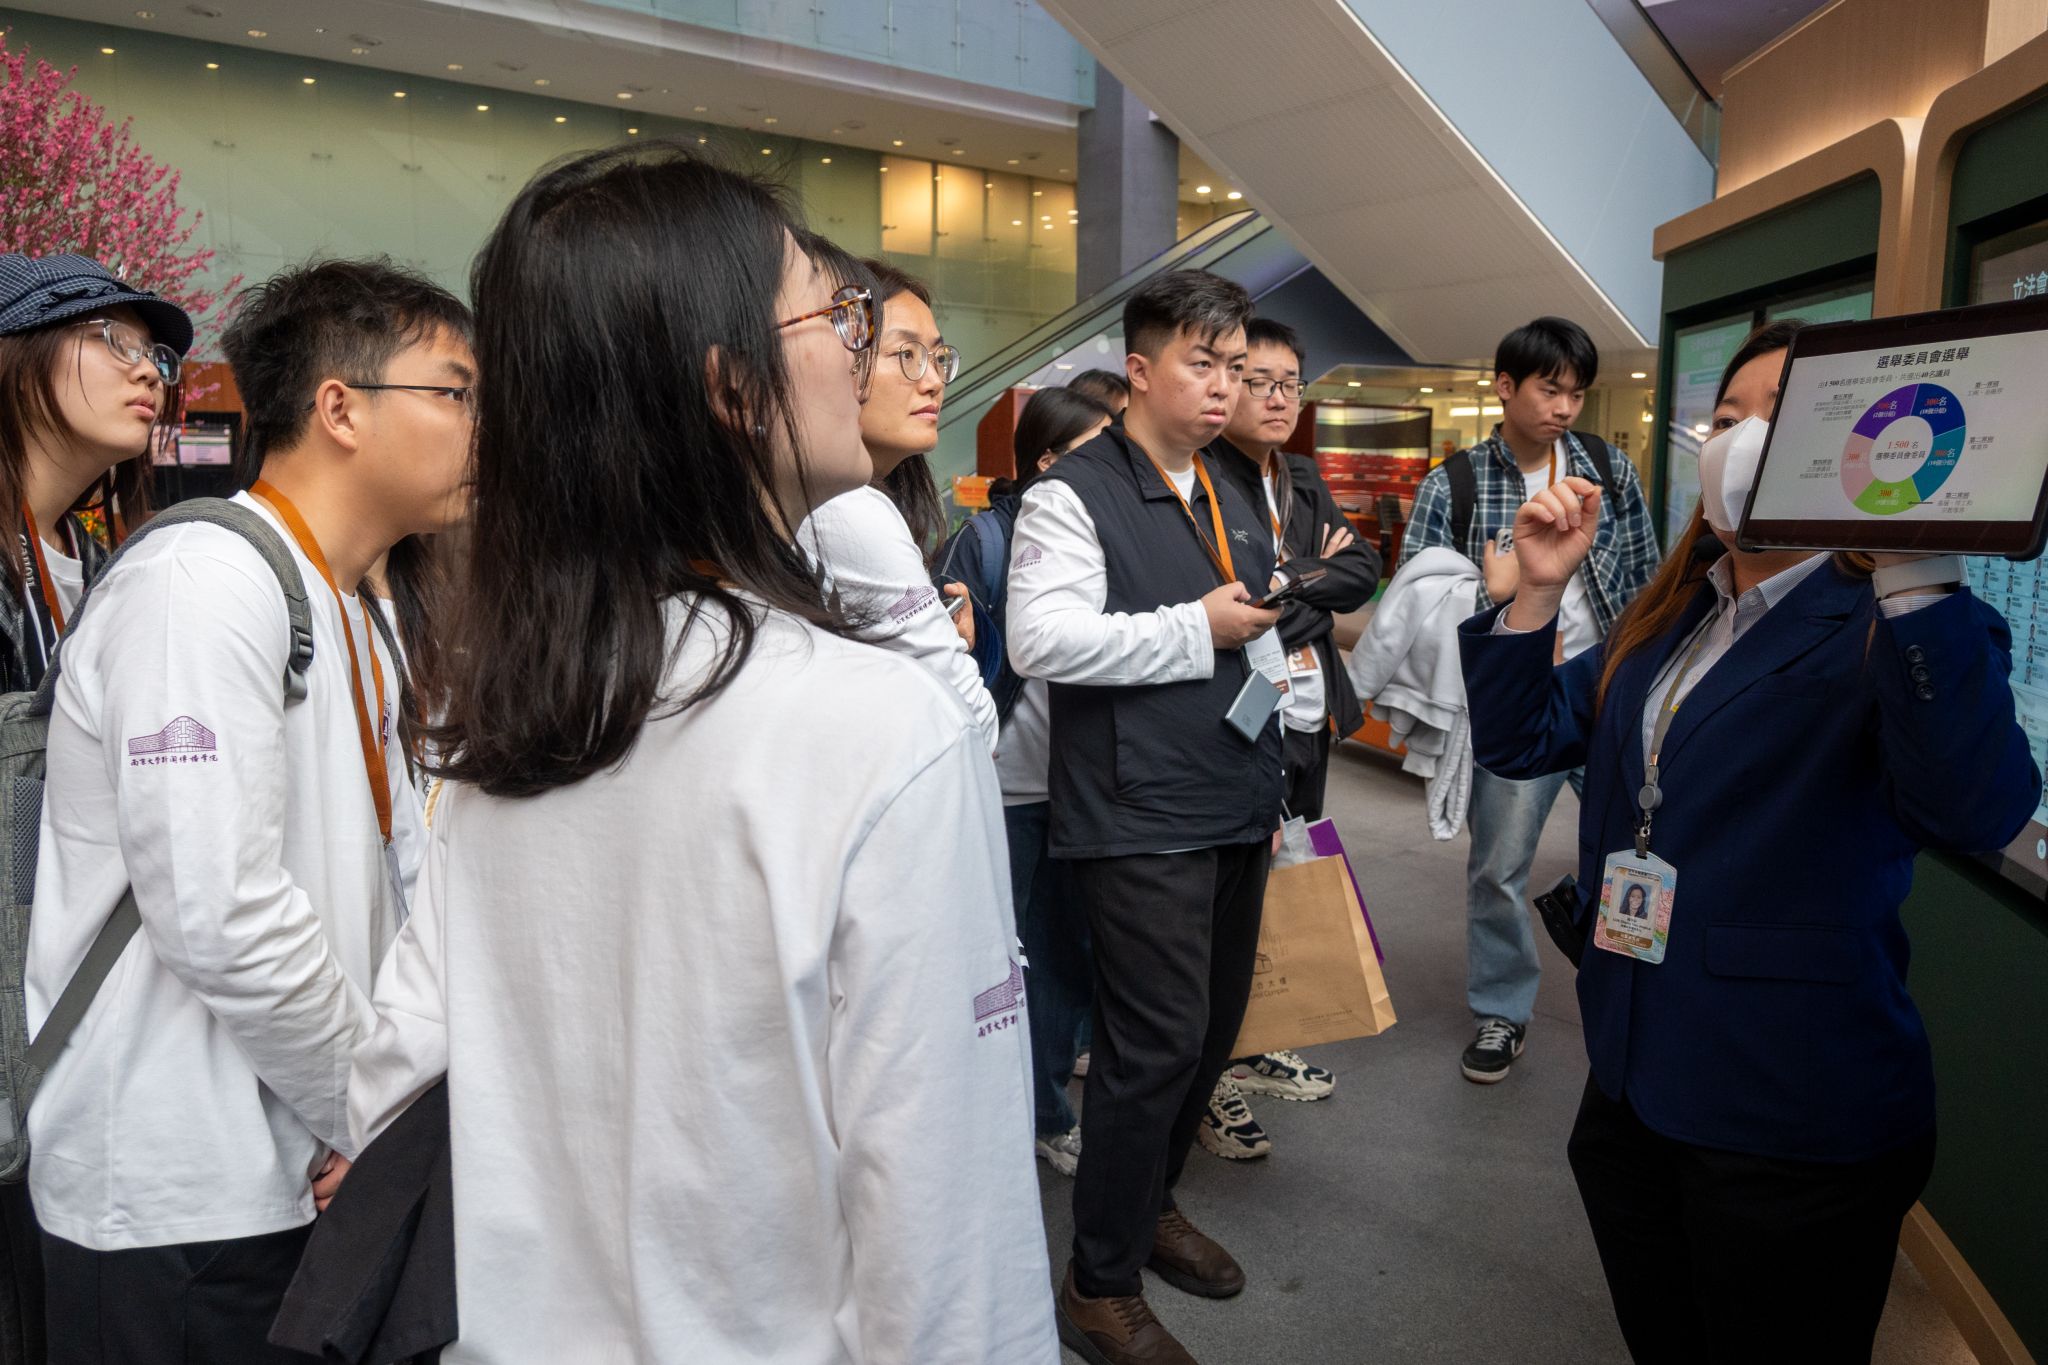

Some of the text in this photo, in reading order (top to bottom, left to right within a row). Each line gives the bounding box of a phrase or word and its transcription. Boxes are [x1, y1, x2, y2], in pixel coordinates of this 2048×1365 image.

[1876, 346, 1970, 369] 選舉委員會選舉
[1874, 450, 1926, 461] 選舉委員會委員
